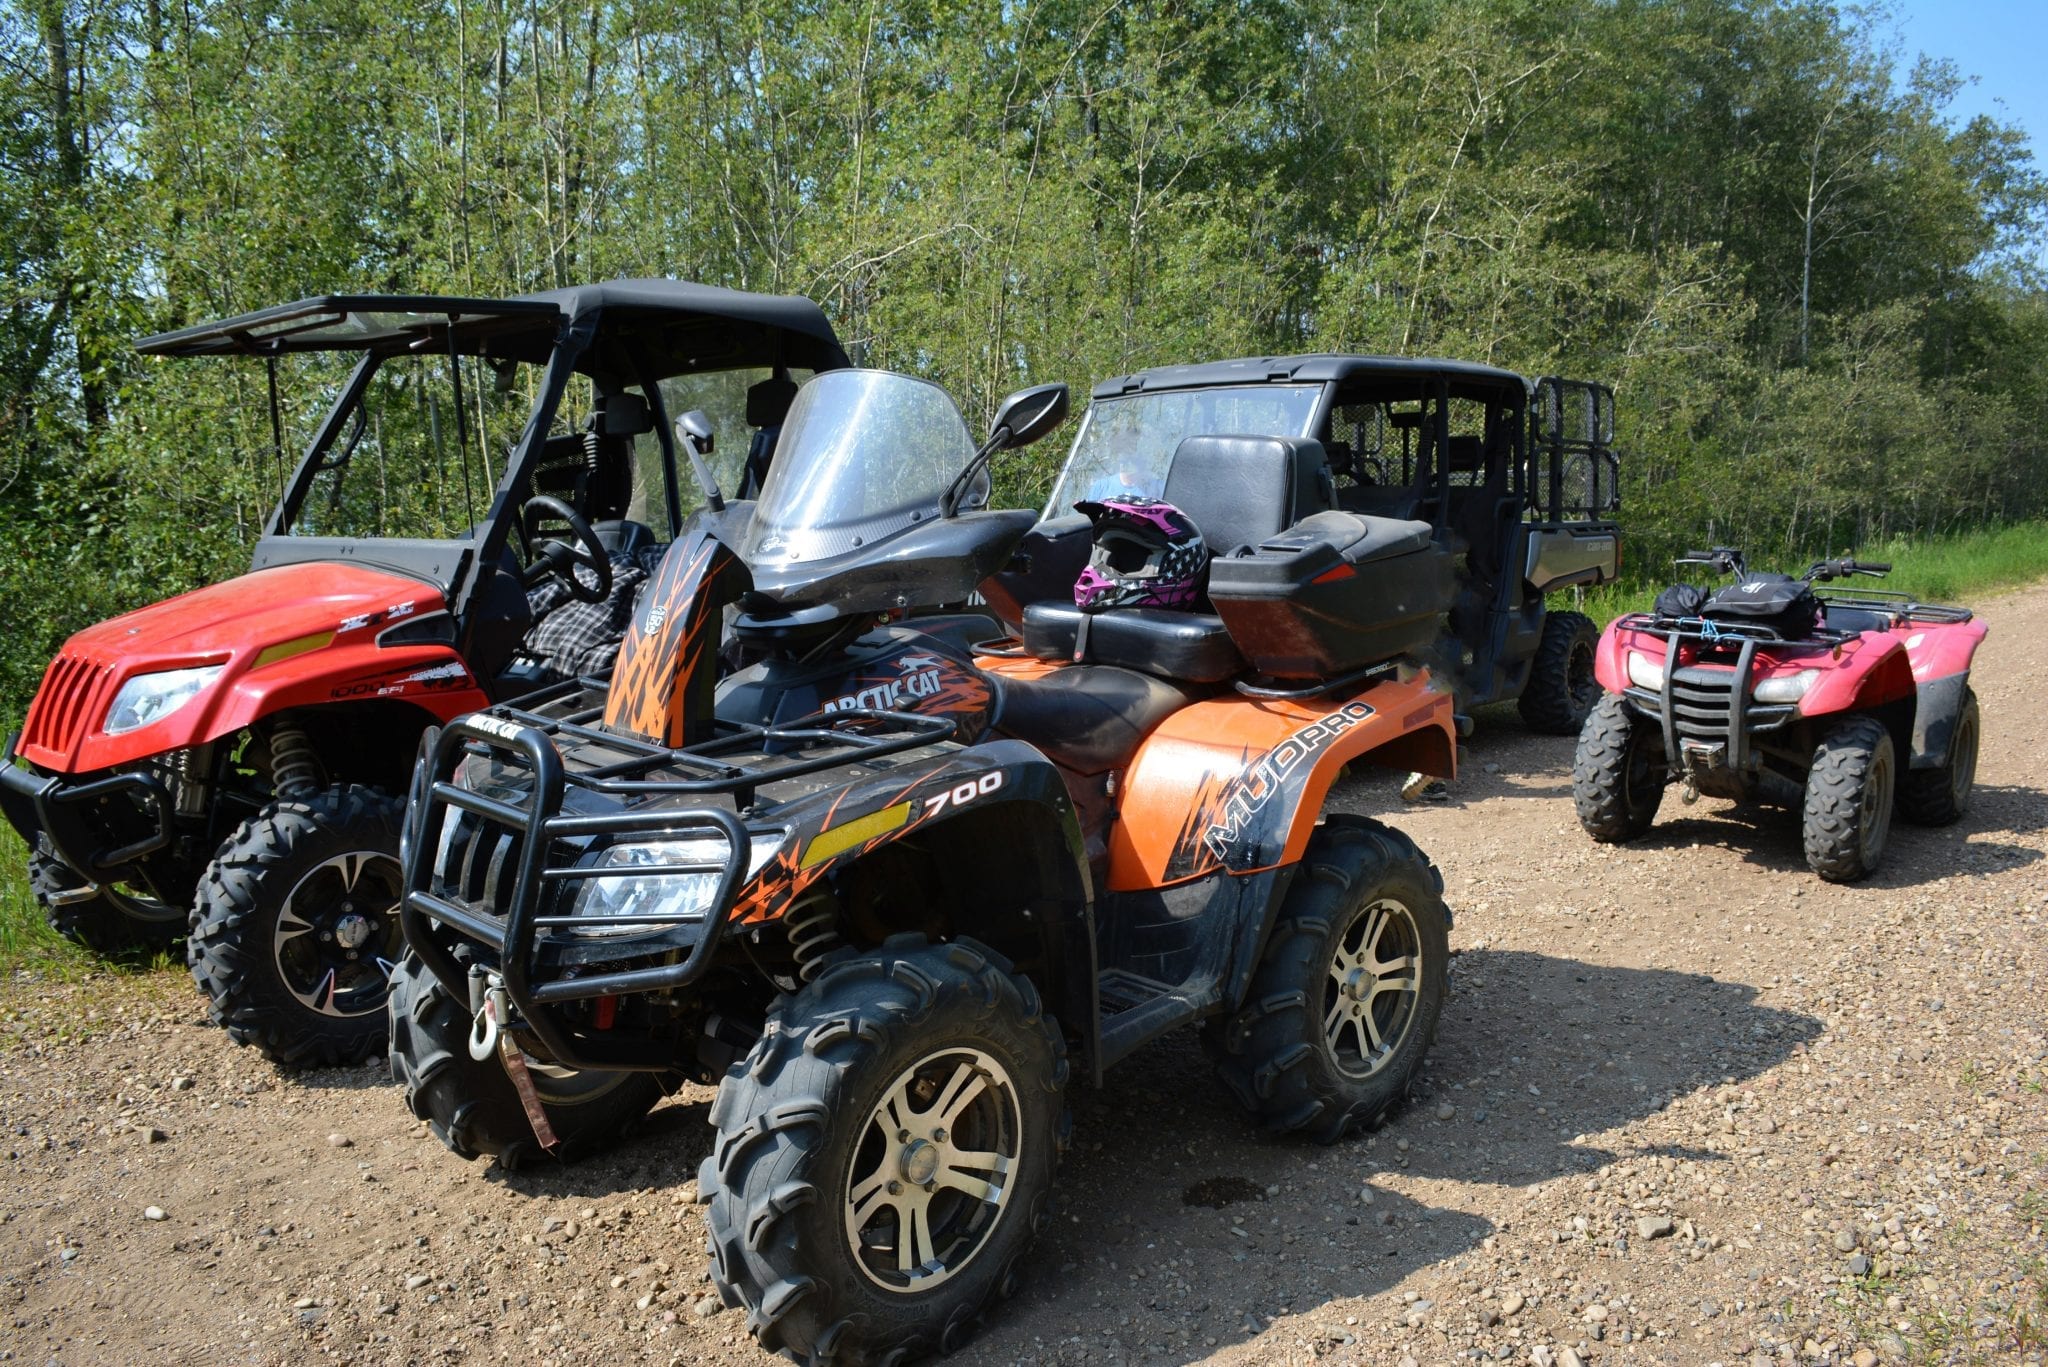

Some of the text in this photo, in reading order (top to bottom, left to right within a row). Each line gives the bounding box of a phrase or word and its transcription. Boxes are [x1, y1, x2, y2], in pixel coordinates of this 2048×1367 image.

[906, 669, 942, 698] CAT
[465, 713, 525, 741] ARCTIC CAT
[924, 770, 1003, 818] 700
[1203, 702, 1376, 861] MUDPRO
